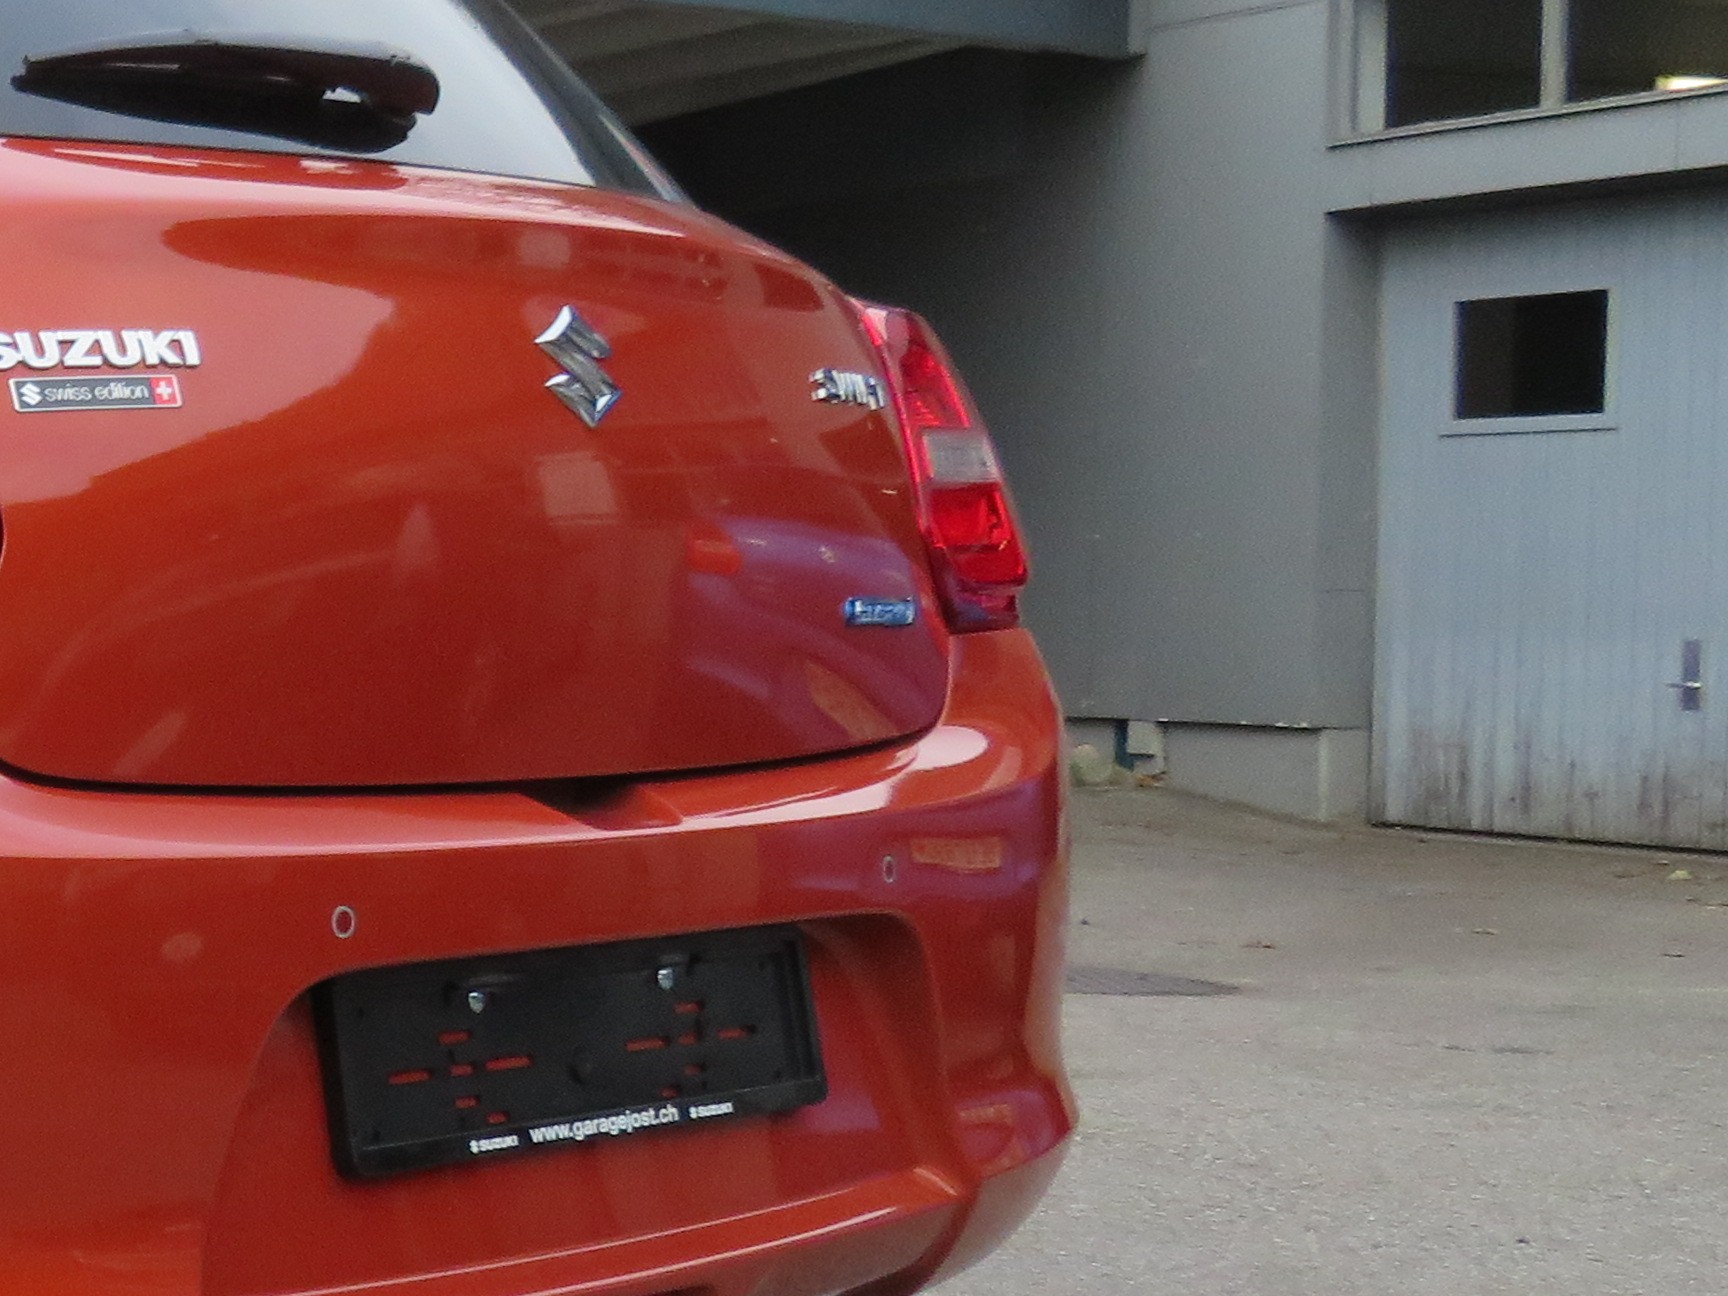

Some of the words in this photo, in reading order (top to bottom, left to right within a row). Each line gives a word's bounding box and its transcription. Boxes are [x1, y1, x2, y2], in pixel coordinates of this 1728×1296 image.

[44, 383, 92, 402] swiss
[94, 382, 150, 401] edition
[529, 1104, 679, 1141] www.garagejost.ch
